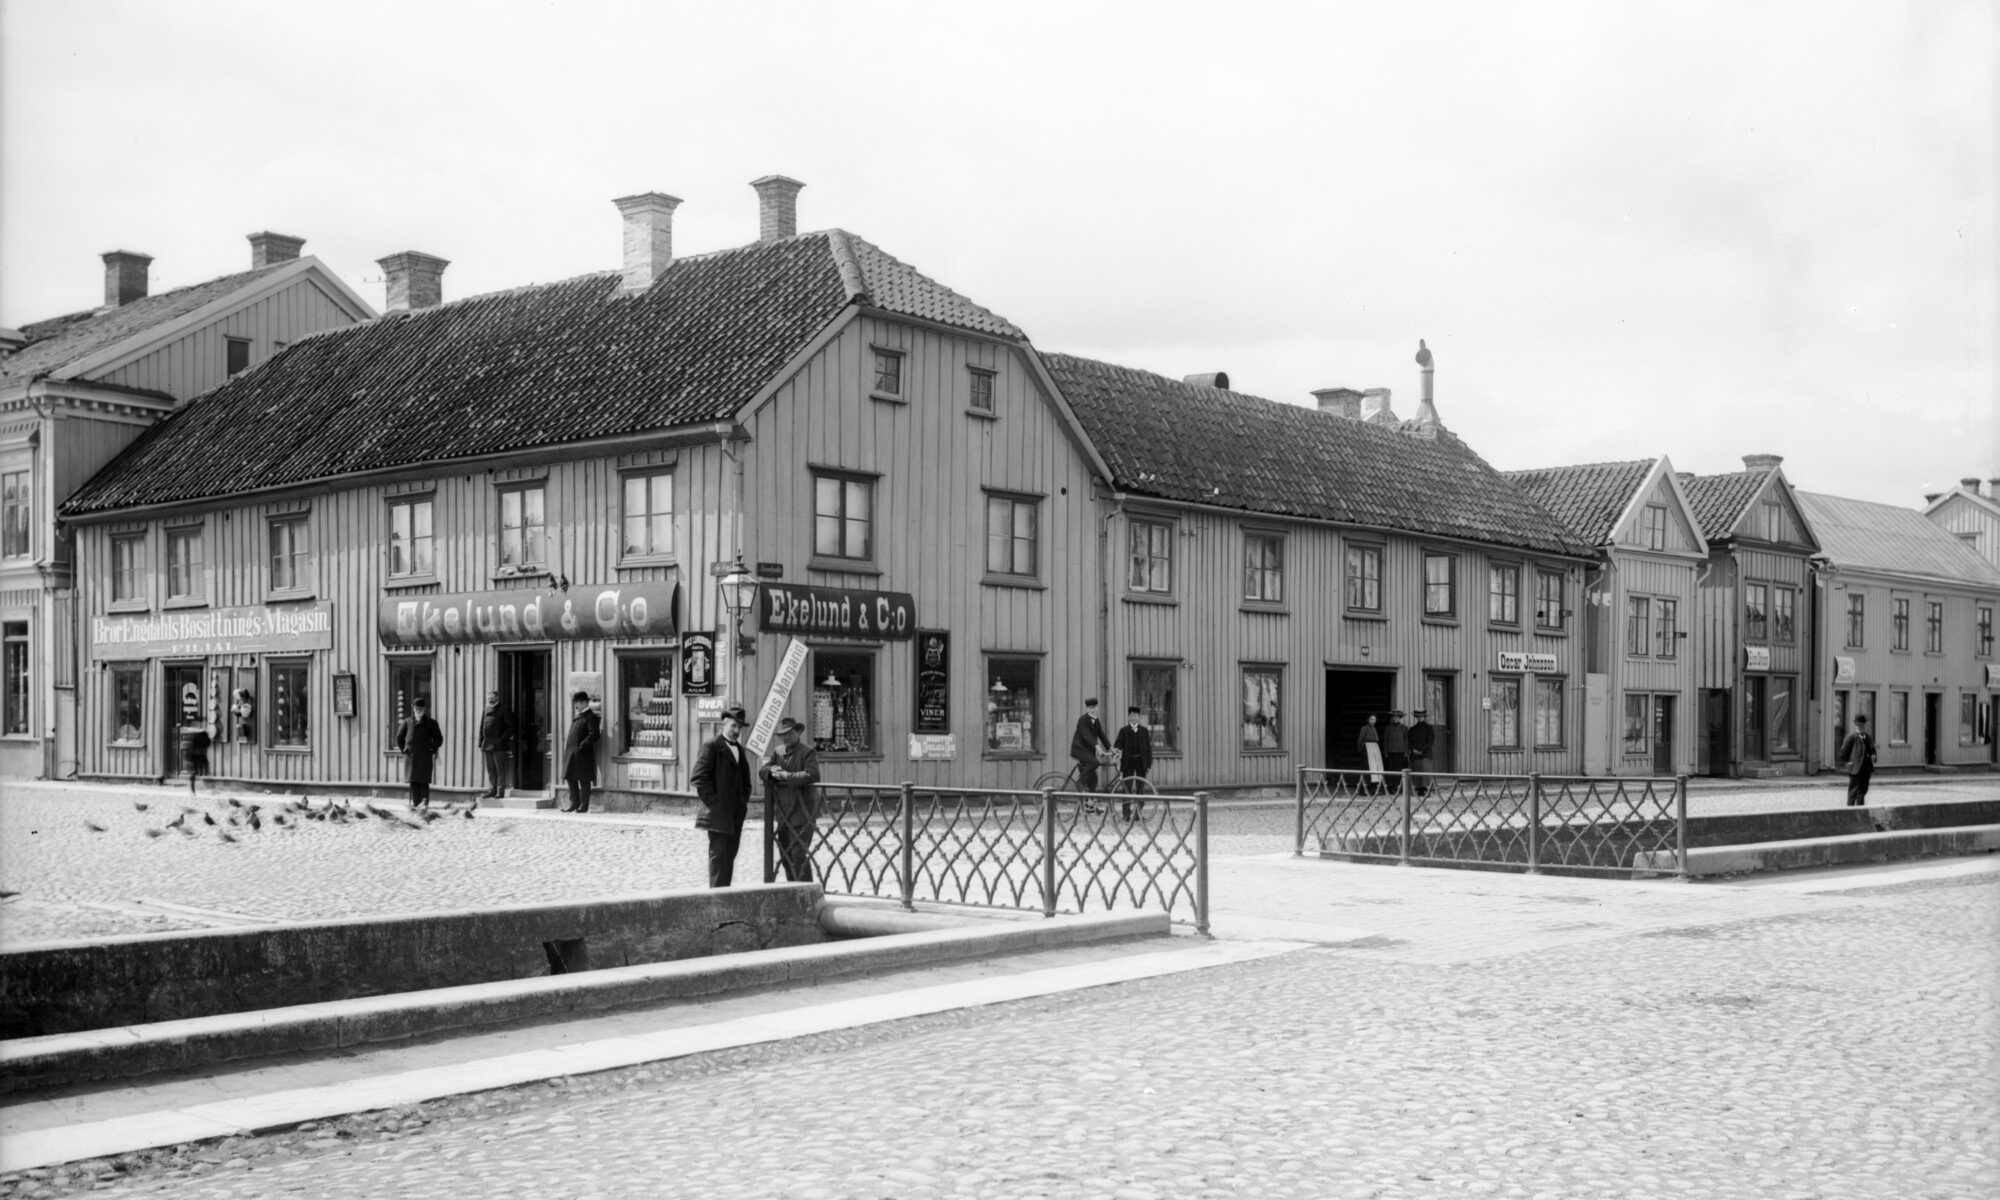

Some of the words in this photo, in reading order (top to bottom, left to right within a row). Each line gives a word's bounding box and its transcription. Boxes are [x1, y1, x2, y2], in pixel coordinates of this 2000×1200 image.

[397, 596, 545, 638] Ekelund
[561, 599, 577, 631] &
[769, 589, 850, 628] Ekelund
[858, 603, 869, 630] &
[876, 597, 906, 631] C:o
[94, 619, 122, 643] Bror
[123, 617, 179, 647] Engdahls
[1501, 653, 1522, 669] Oscar
[749, 697, 783, 753] Pellerins
[773, 644, 805, 699] Margarin
